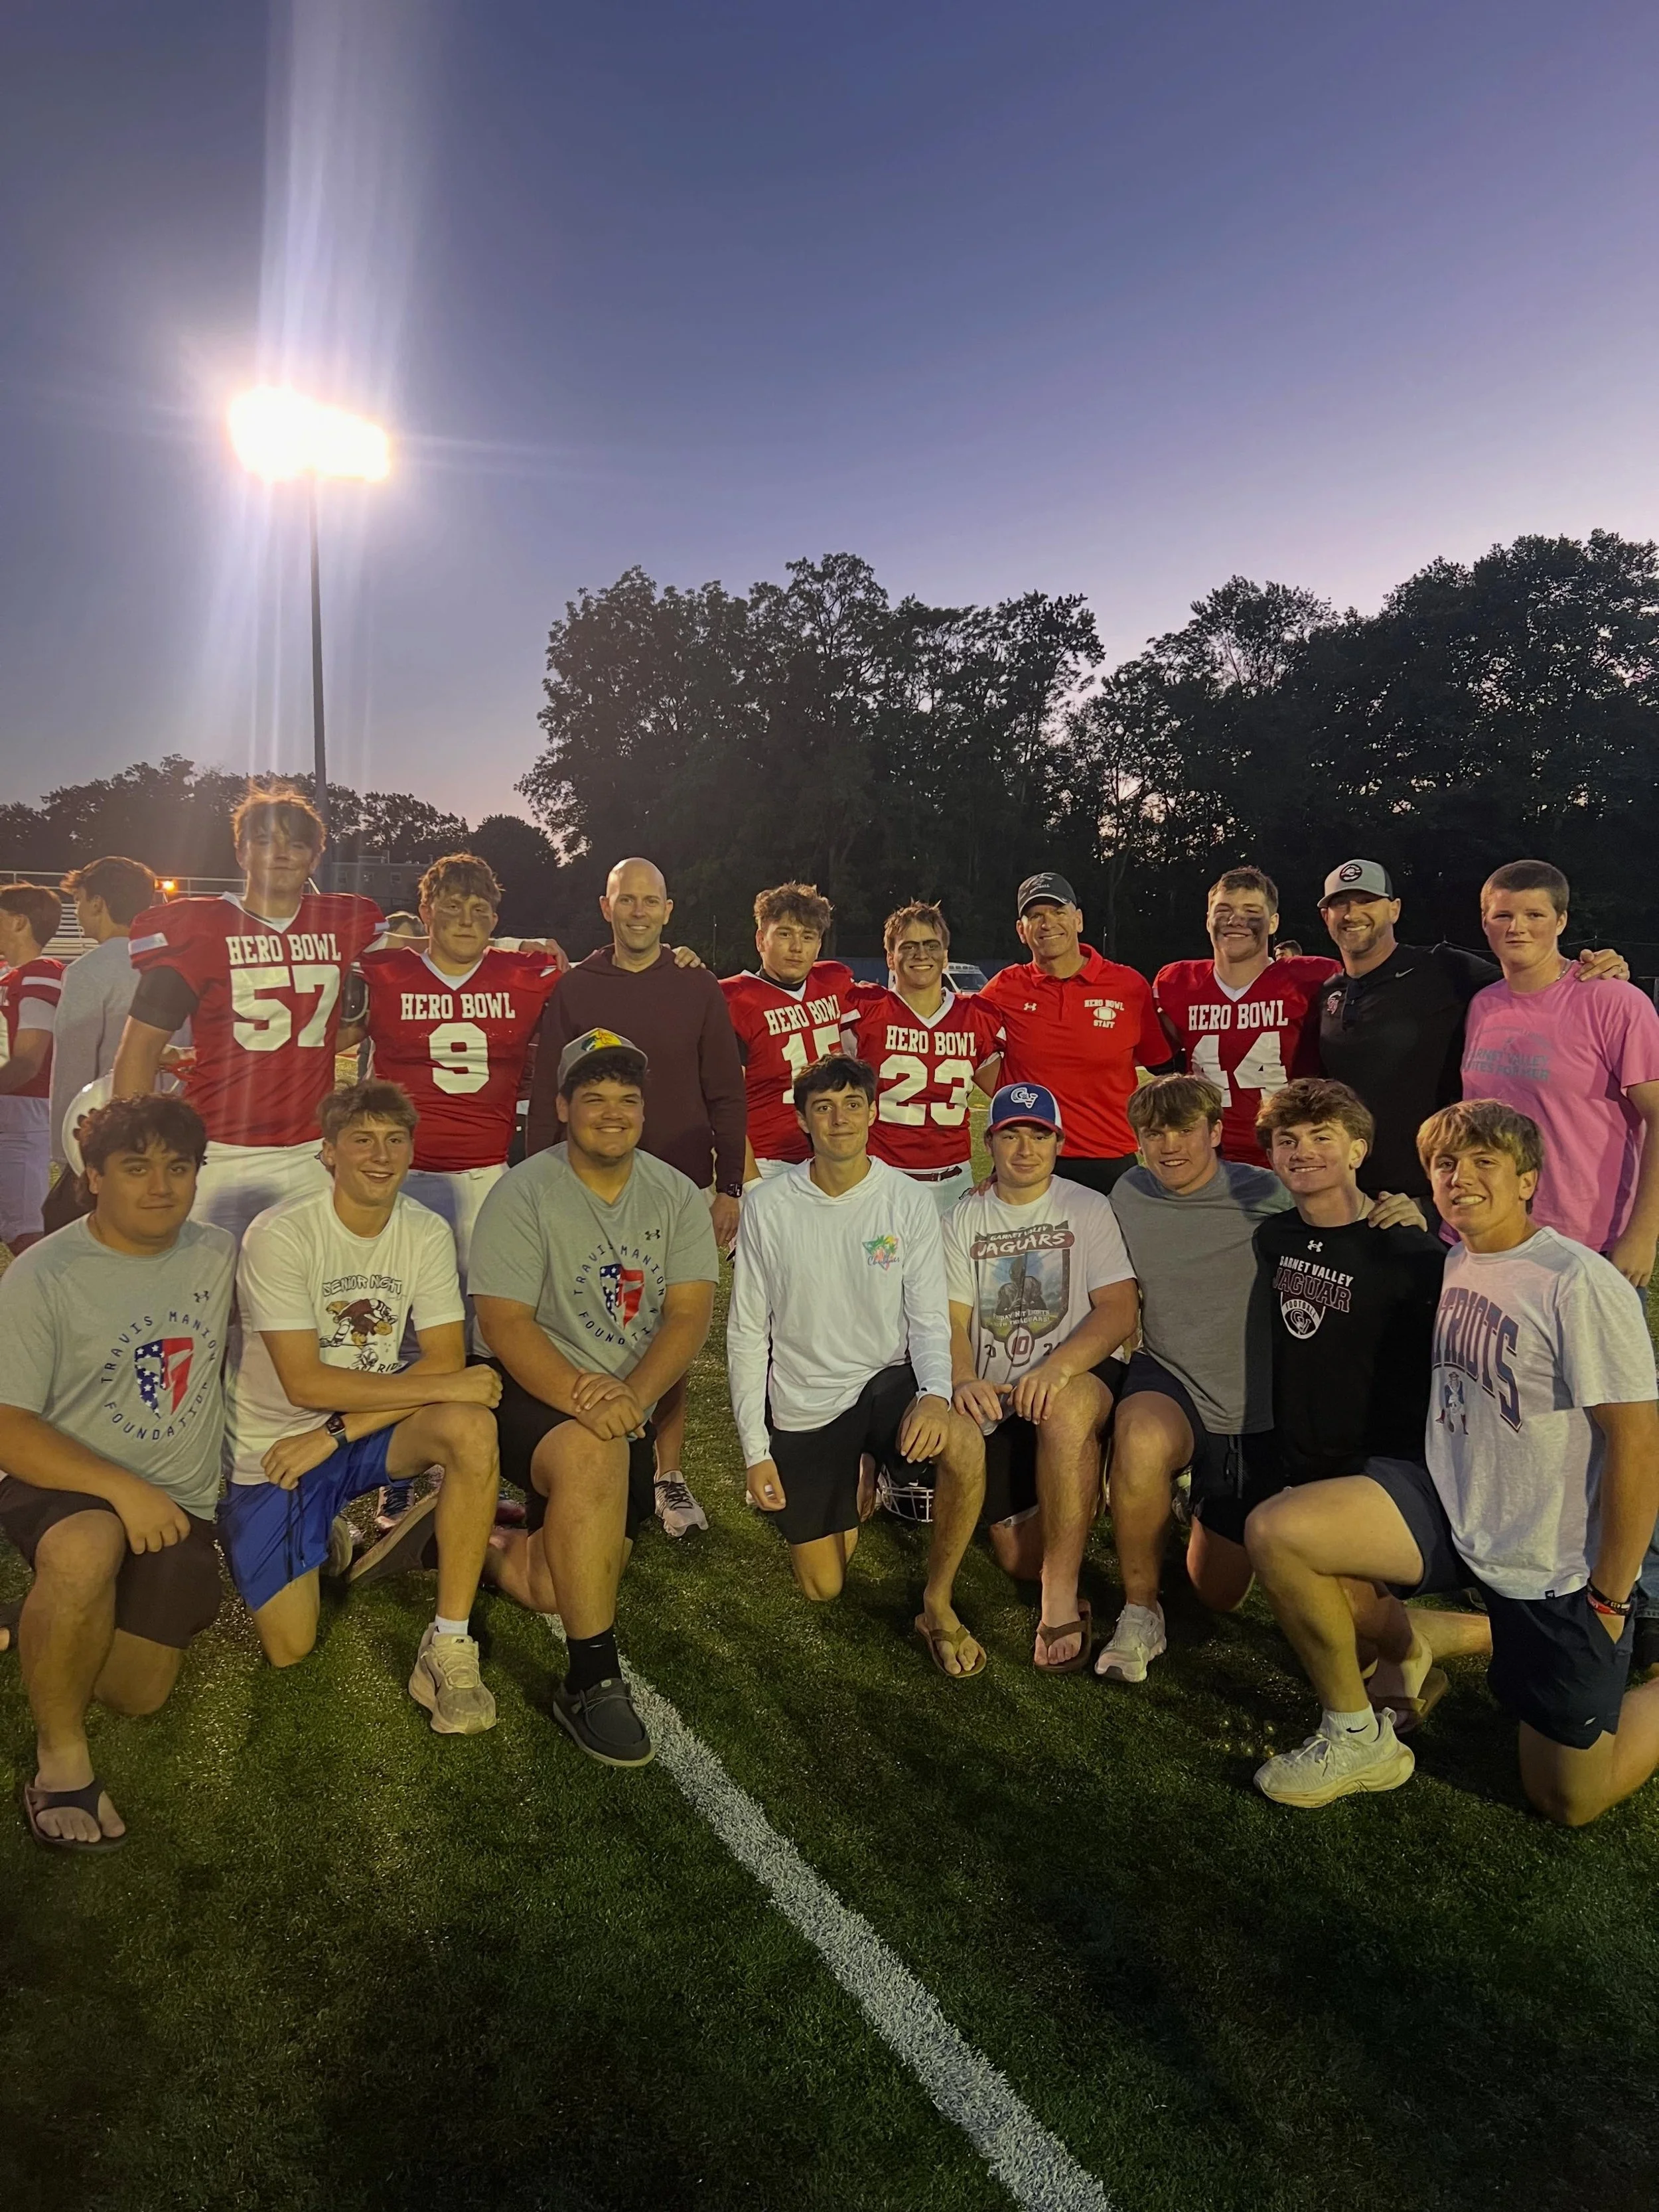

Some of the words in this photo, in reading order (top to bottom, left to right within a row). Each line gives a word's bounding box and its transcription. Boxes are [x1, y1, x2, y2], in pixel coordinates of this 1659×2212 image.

[226, 935, 283, 965] HERO
[287, 934, 341, 960] BOWL
[230, 964, 340, 1051] 57
[401, 994, 453, 1020] HERO
[460, 993, 516, 1019] BOWL
[764, 1003, 810, 1035] HERO
[806, 995, 841, 1025] BOWL
[1105, 999, 1124, 1011] BOWL
[1189, 1005, 1232, 1031] HERO
[1237, 1000, 1289, 1029] BOWL
[1094, 1019, 1115, 1029] STAFF
[885, 1025, 928, 1054] HERO
[934, 1032, 977, 1057] BOWL
[429, 1022, 490, 1094] 9
[1191, 1031, 1289, 1107] 44
[879, 1054, 974, 1126] 23
[978, 1232, 1066, 1256] JAGUARS
[573, 1244, 614, 1295] TRAVI
[620, 1245, 666, 1296] MANION
[1279, 1256, 1311, 1273] GARNET
[1312, 1264, 1354, 1287] VALLEY
[323, 1275, 368, 1297] SENIOR
[1273, 1267, 1352, 1313] JAGUAR
[1285, 1300, 1317, 1318] FOOTBALL
[102, 1317, 153, 1383] TRAVIS
[377, 1363, 402, 1373] RID
